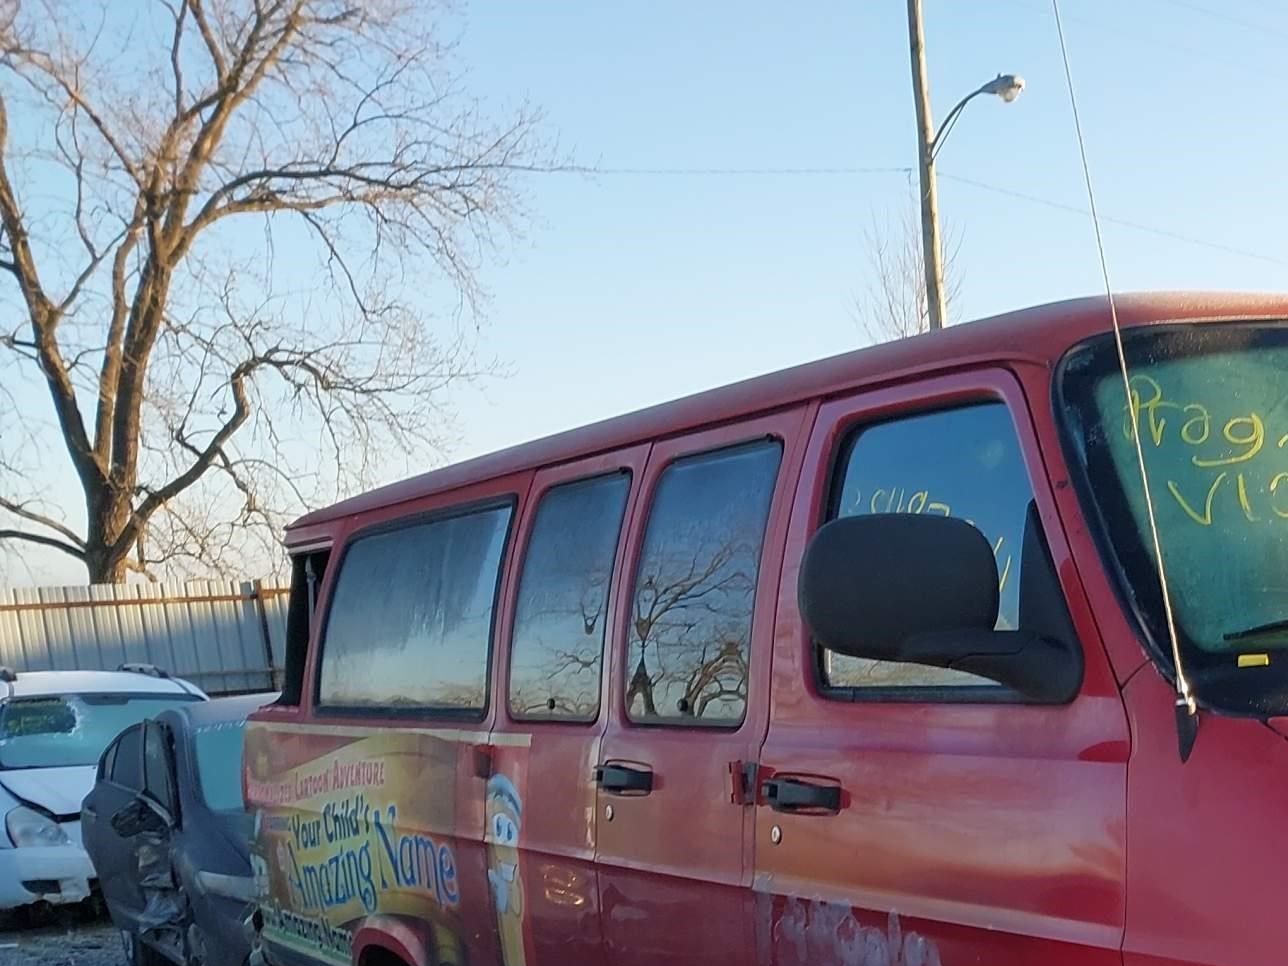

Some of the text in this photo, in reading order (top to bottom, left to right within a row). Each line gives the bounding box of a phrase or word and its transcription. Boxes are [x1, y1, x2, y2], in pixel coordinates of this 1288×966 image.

[288, 805, 459, 913] Amazing Name
[289, 795, 370, 851] Your Child's
